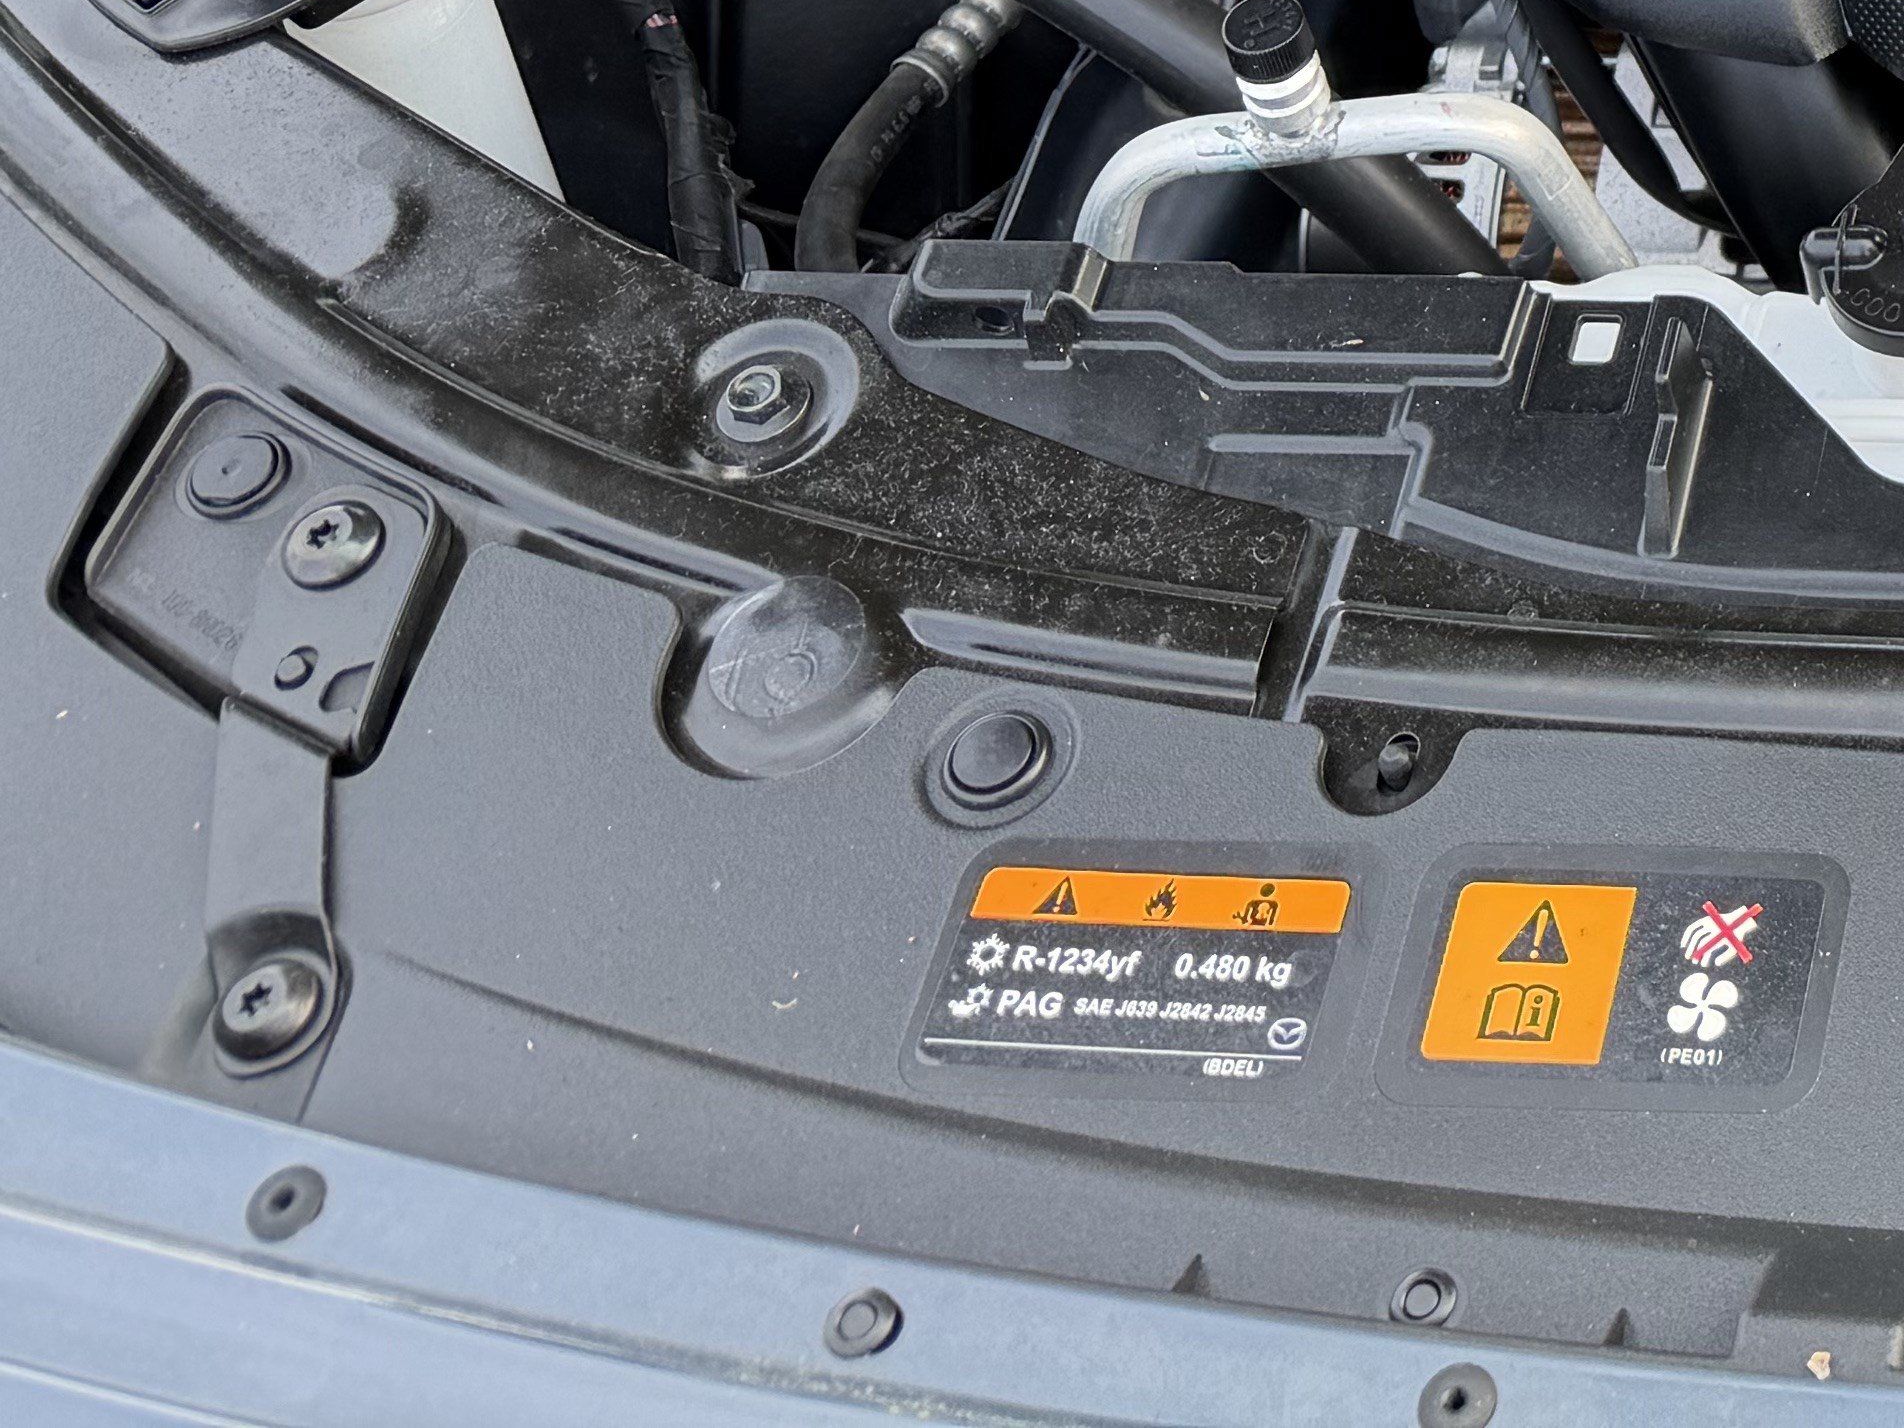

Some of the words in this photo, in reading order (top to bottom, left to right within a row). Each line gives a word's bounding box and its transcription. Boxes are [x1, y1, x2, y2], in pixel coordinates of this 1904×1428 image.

[1012, 944, 1143, 982] R-1234yf
[1174, 952, 1251, 982] 0.480
[1254, 956, 1293, 989] kg
[997, 989, 1064, 1018] PAG
[1073, 997, 1114, 1017] SAE
[1114, 998, 1159, 1019] J639
[1159, 1001, 1212, 1022] J2842
[1213, 1003, 1267, 1024] J2845
[1202, 1058, 1265, 1078] (BDEL)
[1660, 1047, 1723, 1066] (PE01)
